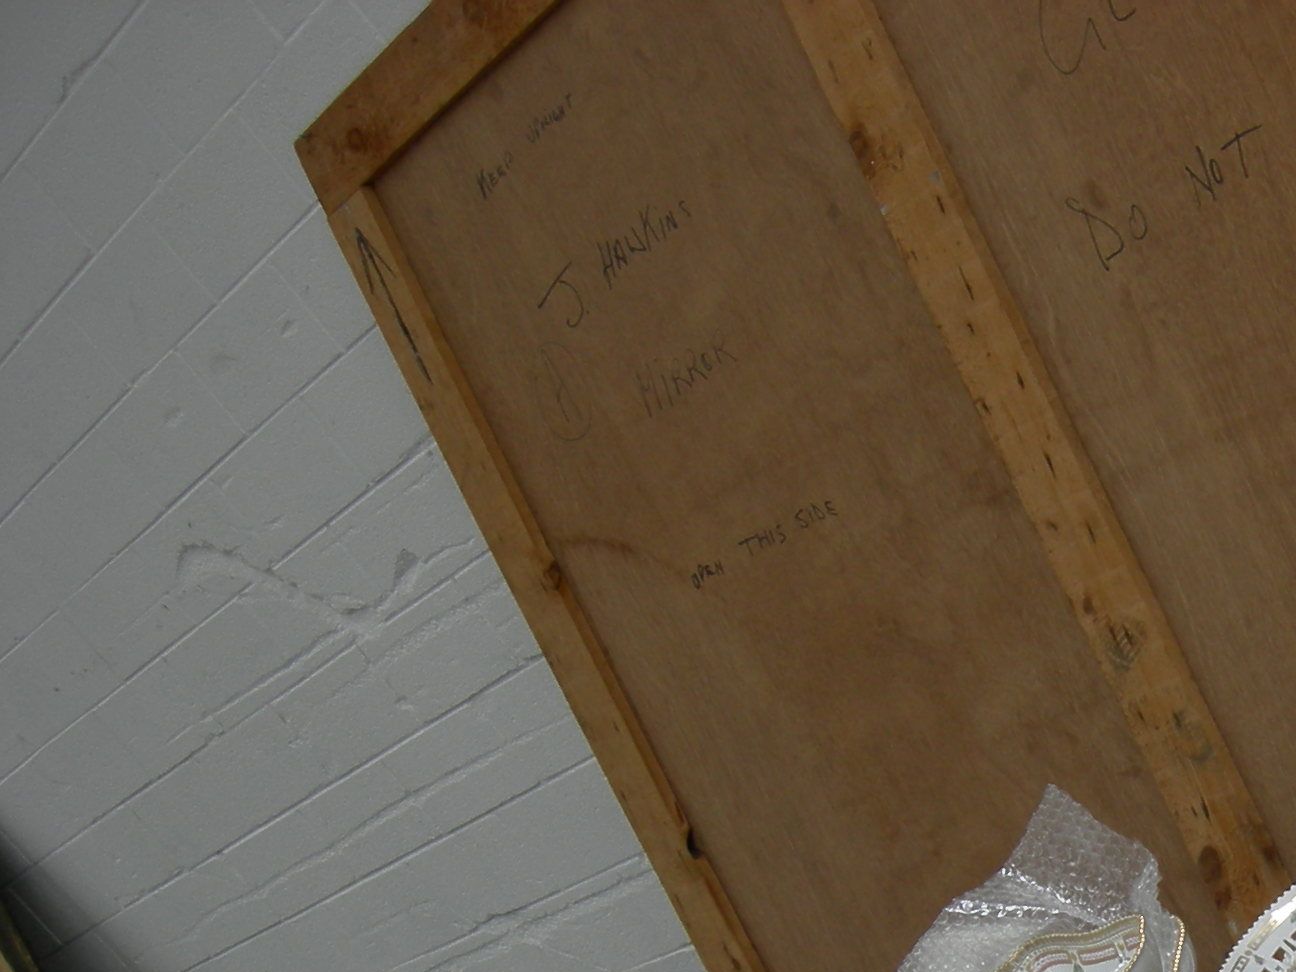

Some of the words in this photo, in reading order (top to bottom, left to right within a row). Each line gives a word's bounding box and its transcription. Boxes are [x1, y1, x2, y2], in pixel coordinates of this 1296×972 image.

[596, 199, 692, 290] HAWKINS
[737, 523, 788, 557] THIS
[794, 500, 839, 529] SIDE
